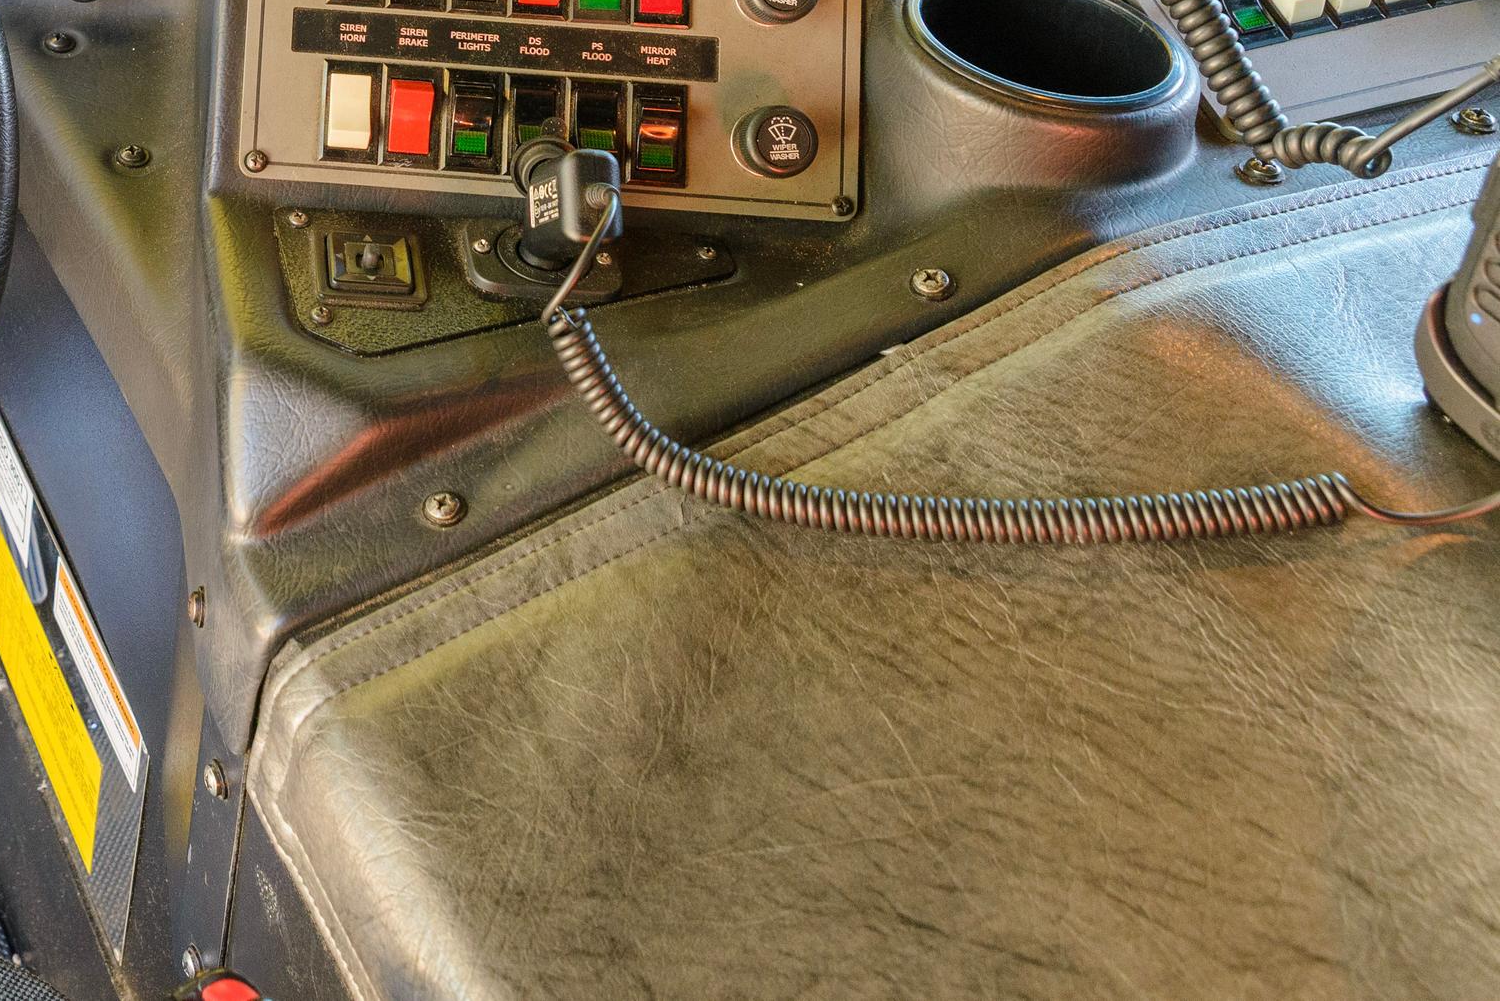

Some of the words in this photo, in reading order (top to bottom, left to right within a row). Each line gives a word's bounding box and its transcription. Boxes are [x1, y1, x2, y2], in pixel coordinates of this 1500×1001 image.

[340, 23, 367, 32] SIREN
[400, 27, 428, 37] SIREN
[340, 33, 366, 43] HORN
[450, 31, 500, 42] PERIMETER
[529, 37, 542, 45] DS
[399, 38, 429, 47] BRAKE
[458, 41, 491, 52] LIGHTS
[591, 42, 603, 51] PS
[519, 46, 550, 56] FLOOD
[640, 46, 677, 56] MIRROR
[582, 52, 612, 61] FLOOD
[647, 56, 671, 66] HEAT
[770, 153, 800, 161] WASHER
